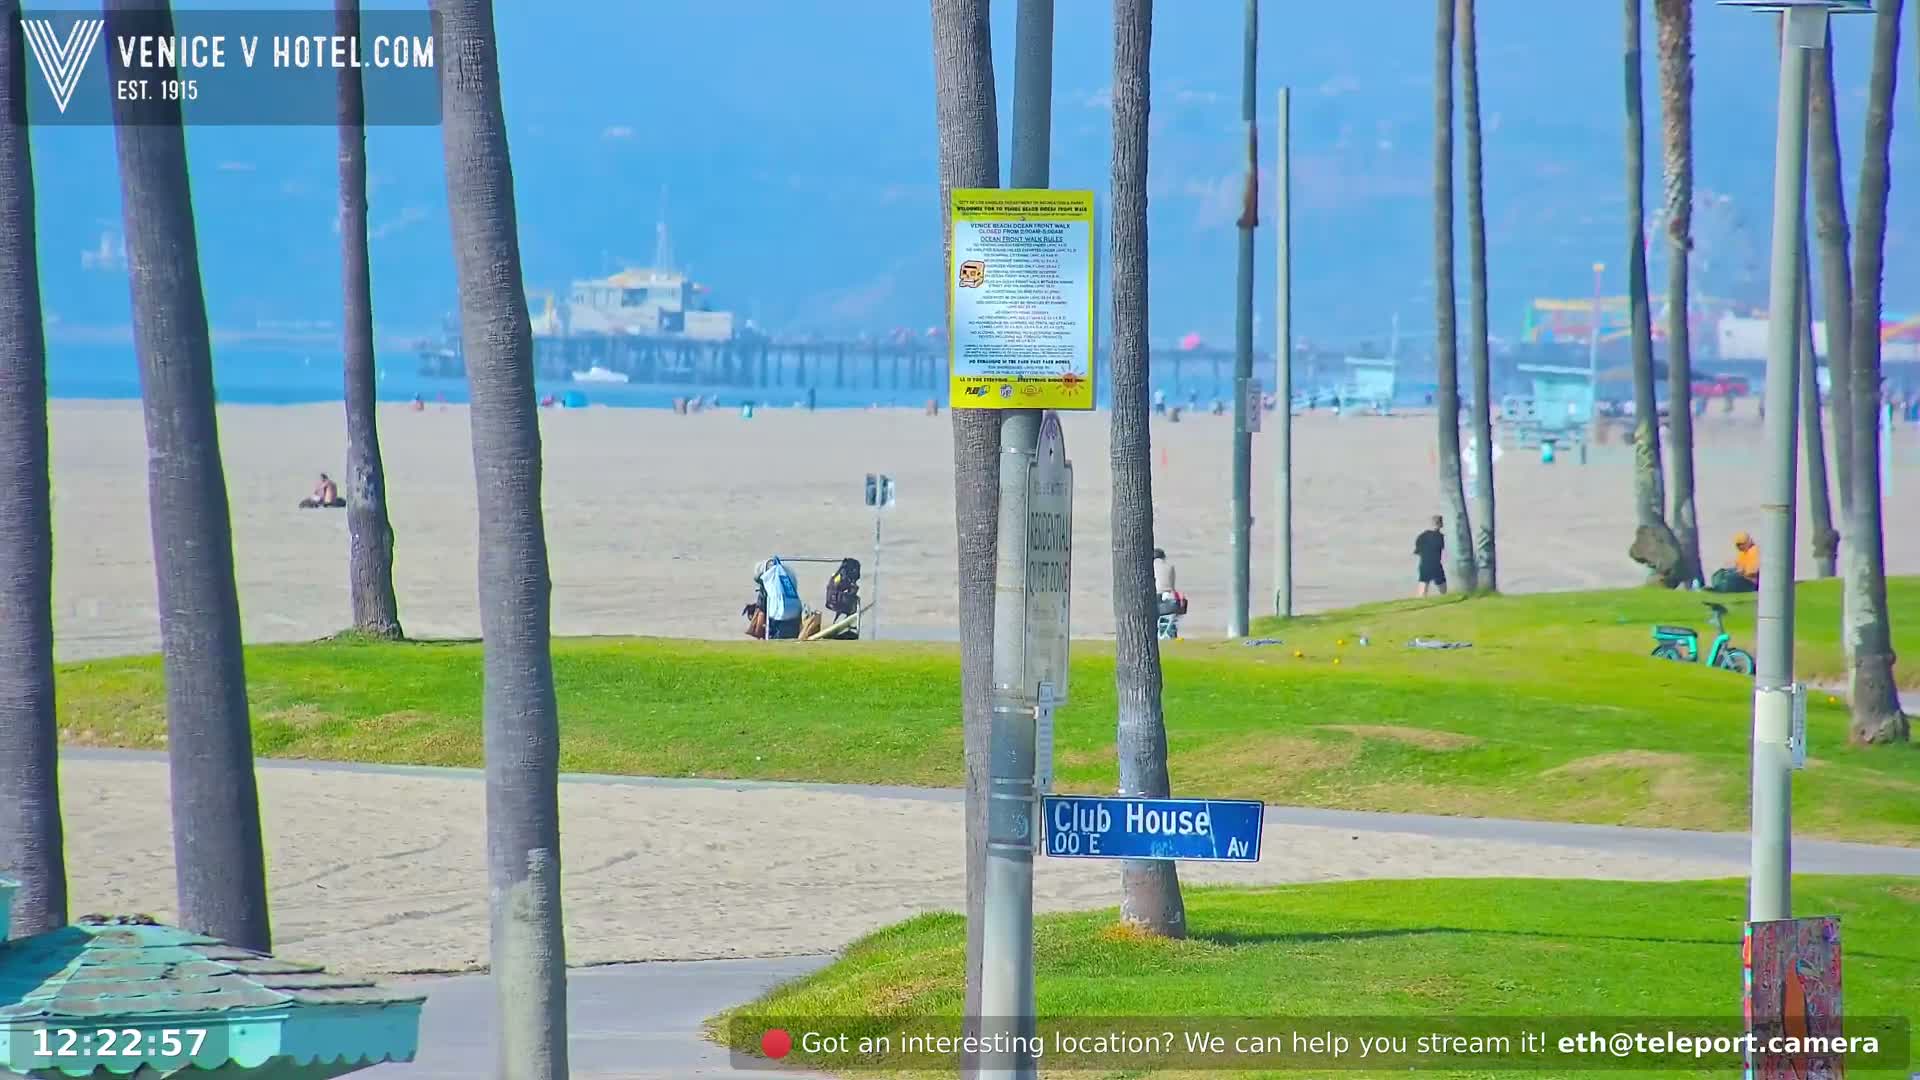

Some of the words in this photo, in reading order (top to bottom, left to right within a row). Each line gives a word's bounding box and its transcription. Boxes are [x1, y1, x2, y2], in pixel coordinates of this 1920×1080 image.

[1030, 512, 1069, 552] RESIDENTIAL
[1029, 561, 1050, 597] QUIET
[1050, 561, 1068, 593] ZONE
[1054, 801, 1112, 833] Club
[1126, 802, 1210, 835] House
[1089, 834, 1101, 854] E
[1227, 837, 1250, 858] Av
